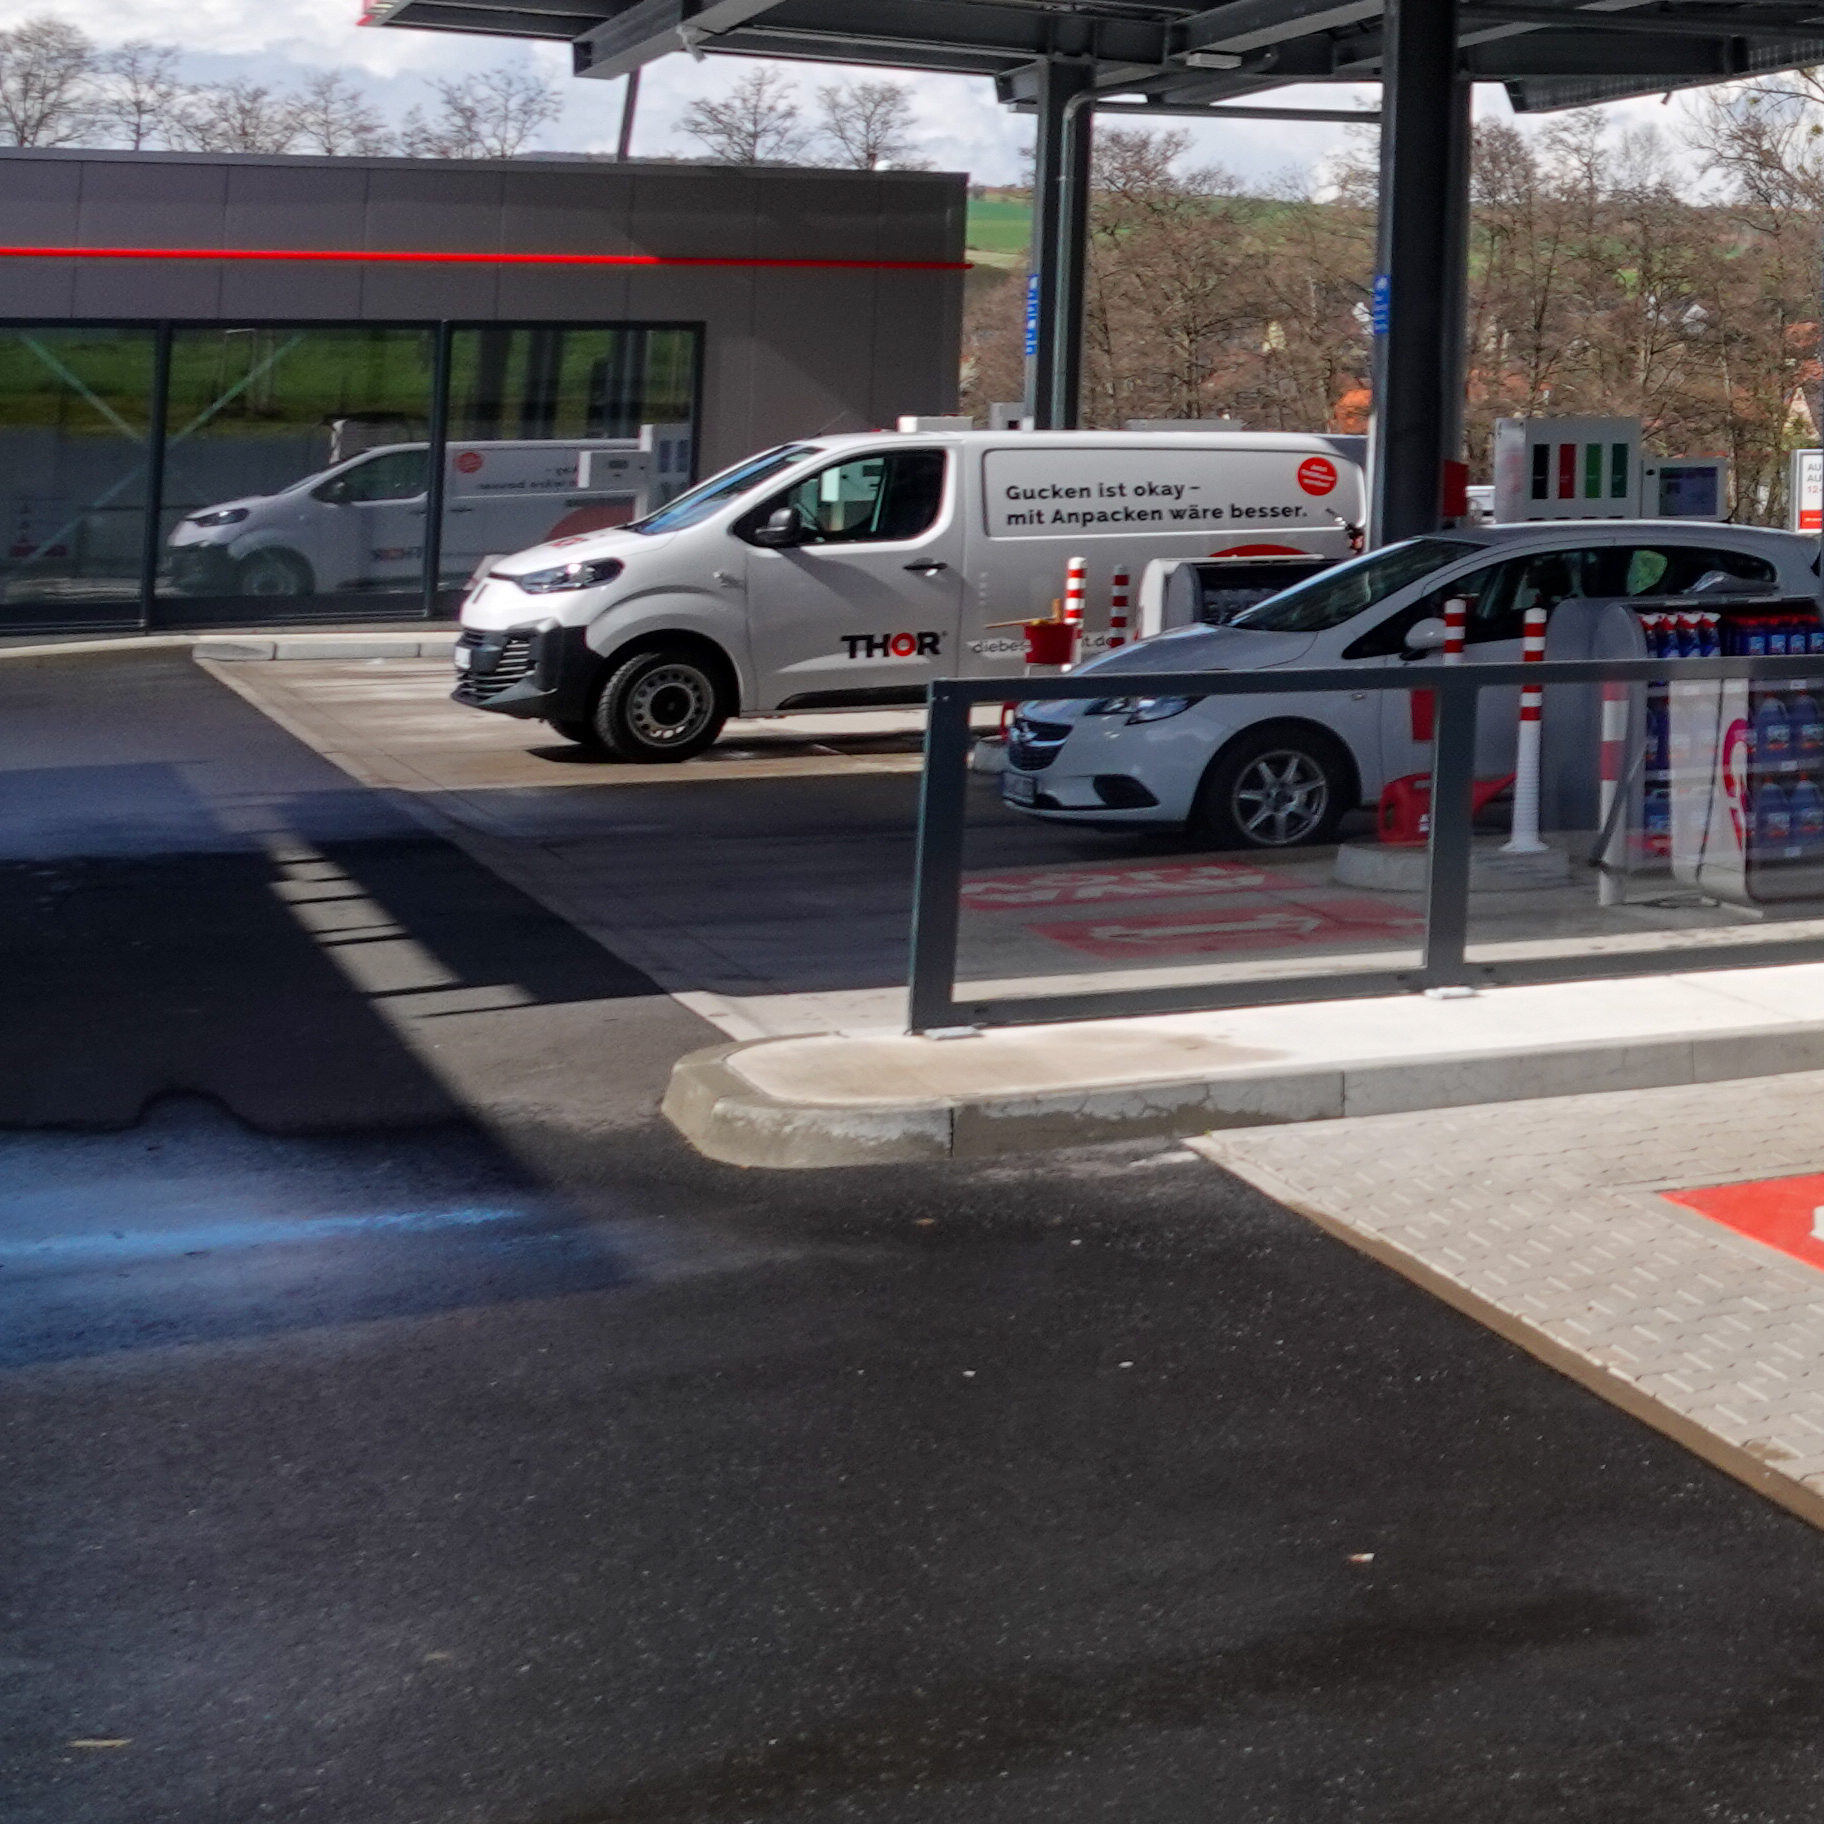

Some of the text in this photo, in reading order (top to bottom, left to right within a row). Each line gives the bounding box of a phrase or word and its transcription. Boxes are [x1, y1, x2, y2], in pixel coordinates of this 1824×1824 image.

[1005, 483, 1092, 500] Gucken
[1098, 481, 1128, 498] ist
[1133, 480, 1185, 500] okay
[1006, 503, 1308, 527] mit Anpacken wäre besser.
